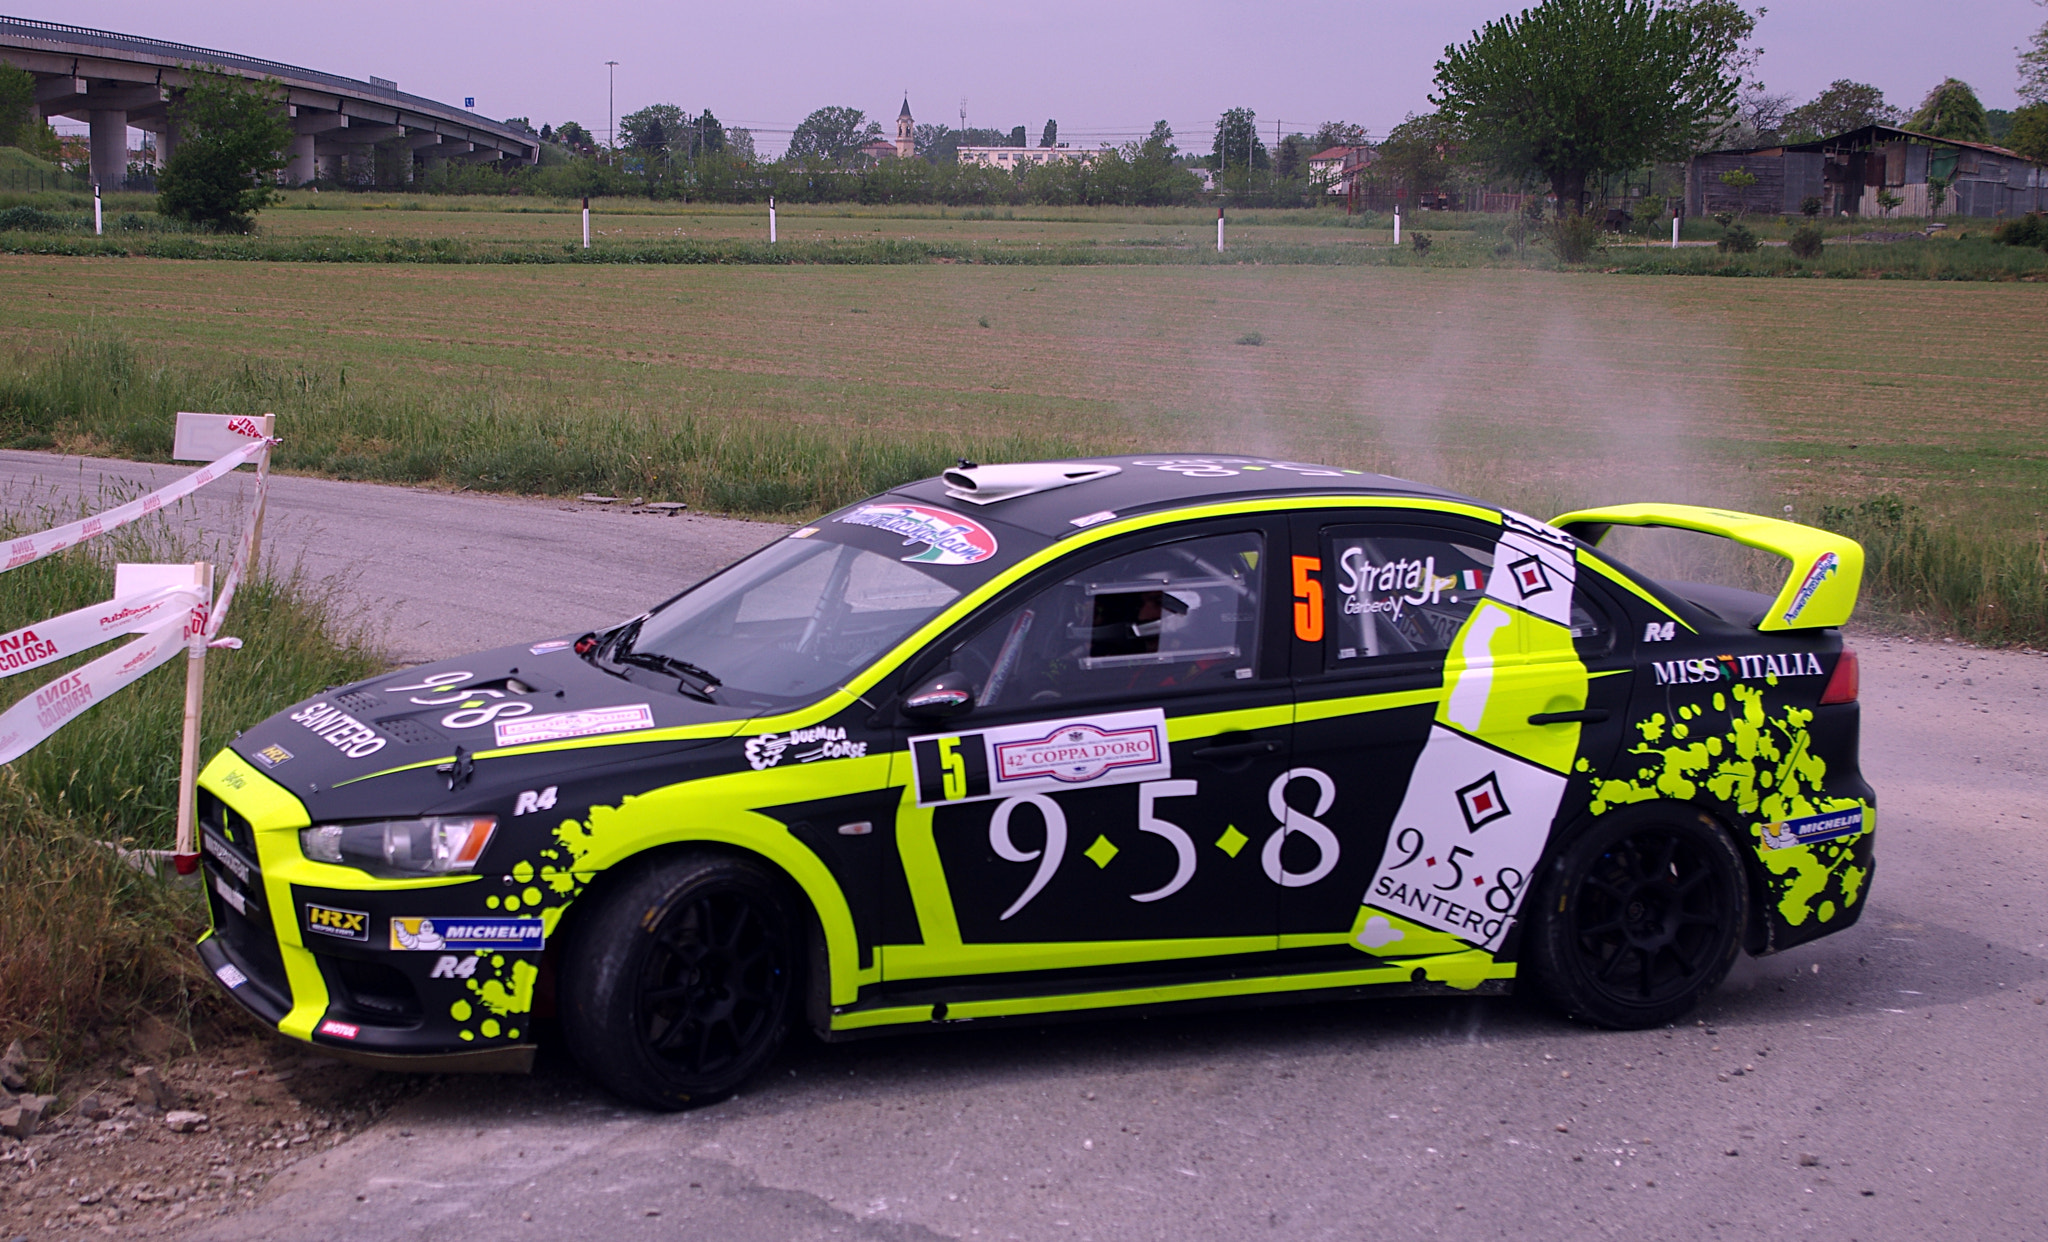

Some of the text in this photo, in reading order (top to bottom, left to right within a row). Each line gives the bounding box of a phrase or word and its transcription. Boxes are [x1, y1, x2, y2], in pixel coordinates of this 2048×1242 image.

[1338, 547, 1421, 594] Strata
[1291, 556, 1325, 642] 5
[1642, 621, 1675, 643] R4
[1652, 652, 1824, 686] MISS ITALIA
[290, 702, 387, 758] SANTERO
[789, 725, 847, 746] DUEMILA
[822, 740, 868, 759] CORSE
[1031, 744, 1089, 765] COPPA
[1094, 740, 1150, 758] D'ORO
[938, 735, 967, 802] 5
[513, 785, 559, 817] R4
[1798, 813, 1863, 835] MICHELIN
[310, 907, 365, 932] HRX
[1375, 876, 1503, 942] SANTERO
[446, 925, 542, 940] MICHELIN
[429, 955, 480, 979] R4
[322, 1021, 358, 1038] MOTUL
